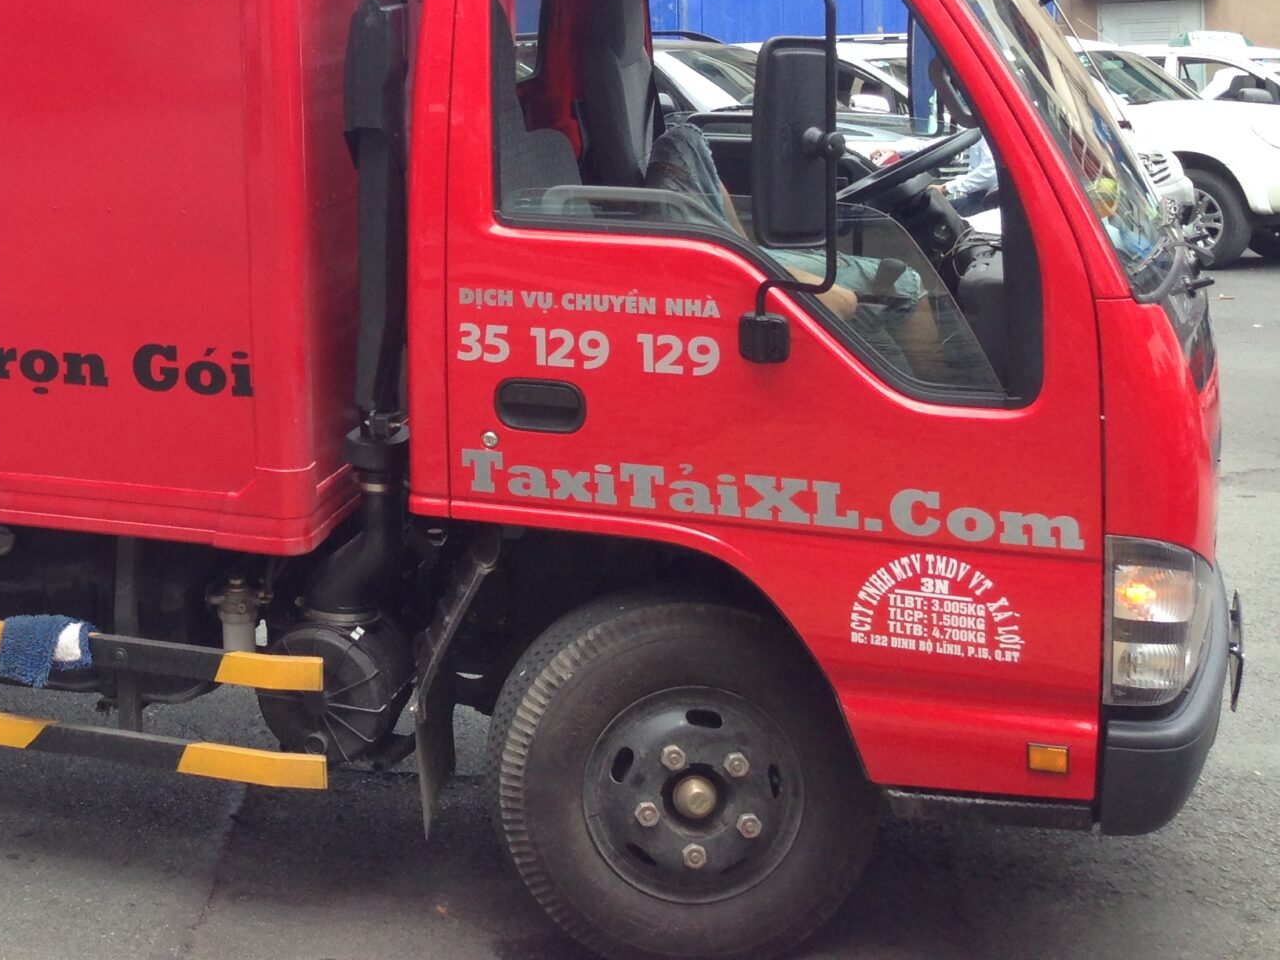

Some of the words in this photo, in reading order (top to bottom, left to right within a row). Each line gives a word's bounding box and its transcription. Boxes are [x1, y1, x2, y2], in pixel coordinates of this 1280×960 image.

[459, 287, 514, 310] DỊCH
[561, 289, 656, 315] CHUYỂN
[665, 295, 720, 318] NHÀ
[457, 323, 511, 363] 35
[530, 327, 610, 370] 129
[637, 333, 721, 376] 129
[132, 343, 254, 397] Gói
[462, 448, 1085, 550] TaxiTảiXL.Com
[888, 553, 921, 582] MTV
[925, 553, 970, 582] TMDV
[857, 567, 896, 606] TNHH
[920, 577, 949, 595] 3N
[968, 570, 993, 596] VT
[850, 602, 874, 631] CTY
[887, 593, 928, 610] TLBT:
[931, 599, 986, 617] 3.005KG
[887, 607, 928, 624] TLCP:
[931, 613, 986, 630] 1.500KG
[870, 634, 888, 647] 122
[887, 620, 928, 637] TLTB:
[931, 626, 986, 644] 4.700KG
